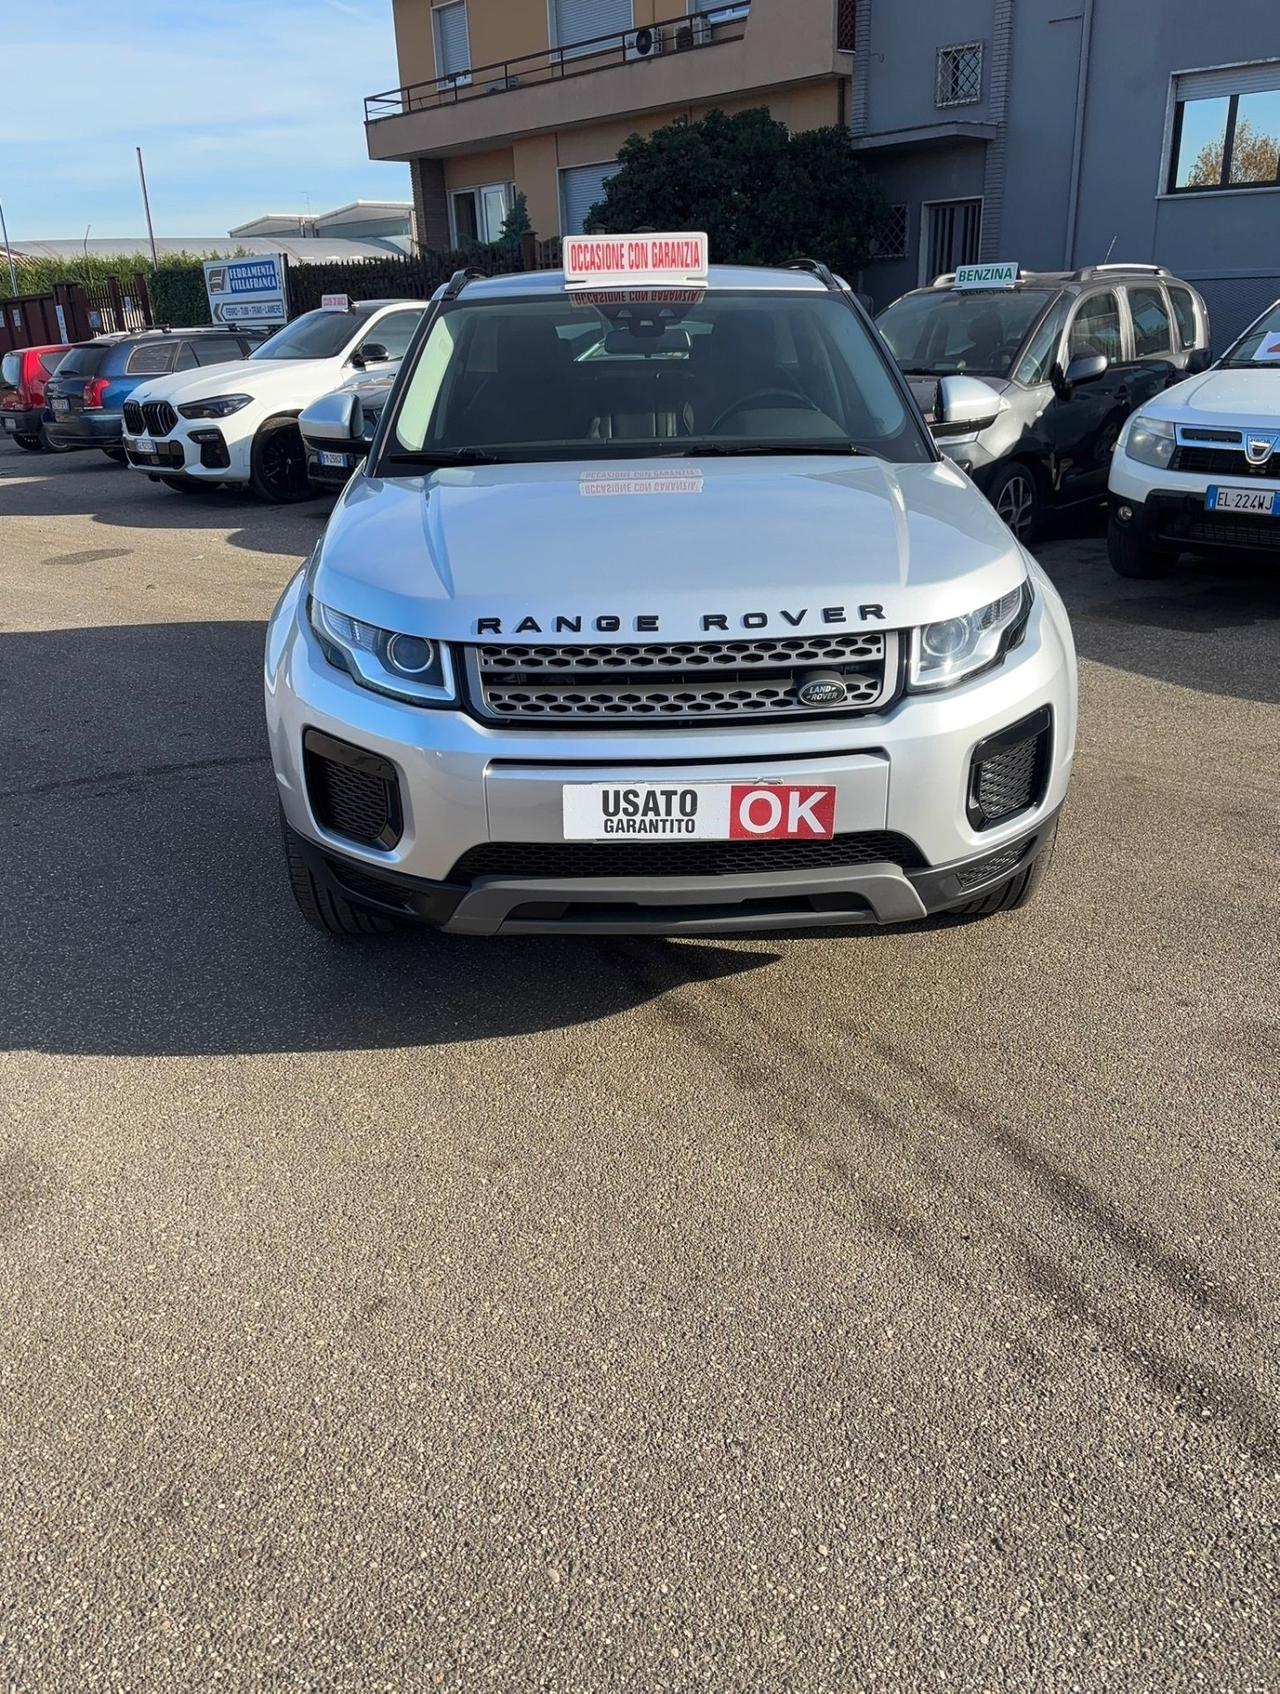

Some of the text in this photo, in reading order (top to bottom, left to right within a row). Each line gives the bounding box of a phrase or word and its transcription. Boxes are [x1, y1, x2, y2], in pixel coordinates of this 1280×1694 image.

[571, 240, 700, 271] OCCASIONE CON GARANZIA
[229, 264, 275, 279] FERRAMENTA
[958, 267, 1012, 282] BENZINA
[231, 276, 277, 290] VILLAFRANCA
[476, 604, 887, 635] RANGE ROVER
[809, 685, 832, 694] LAND
[810, 691, 838, 701] ROVER
[601, 789, 699, 818] USATO
[739, 789, 829, 834] OK
[603, 818, 696, 834] GARANTITO
